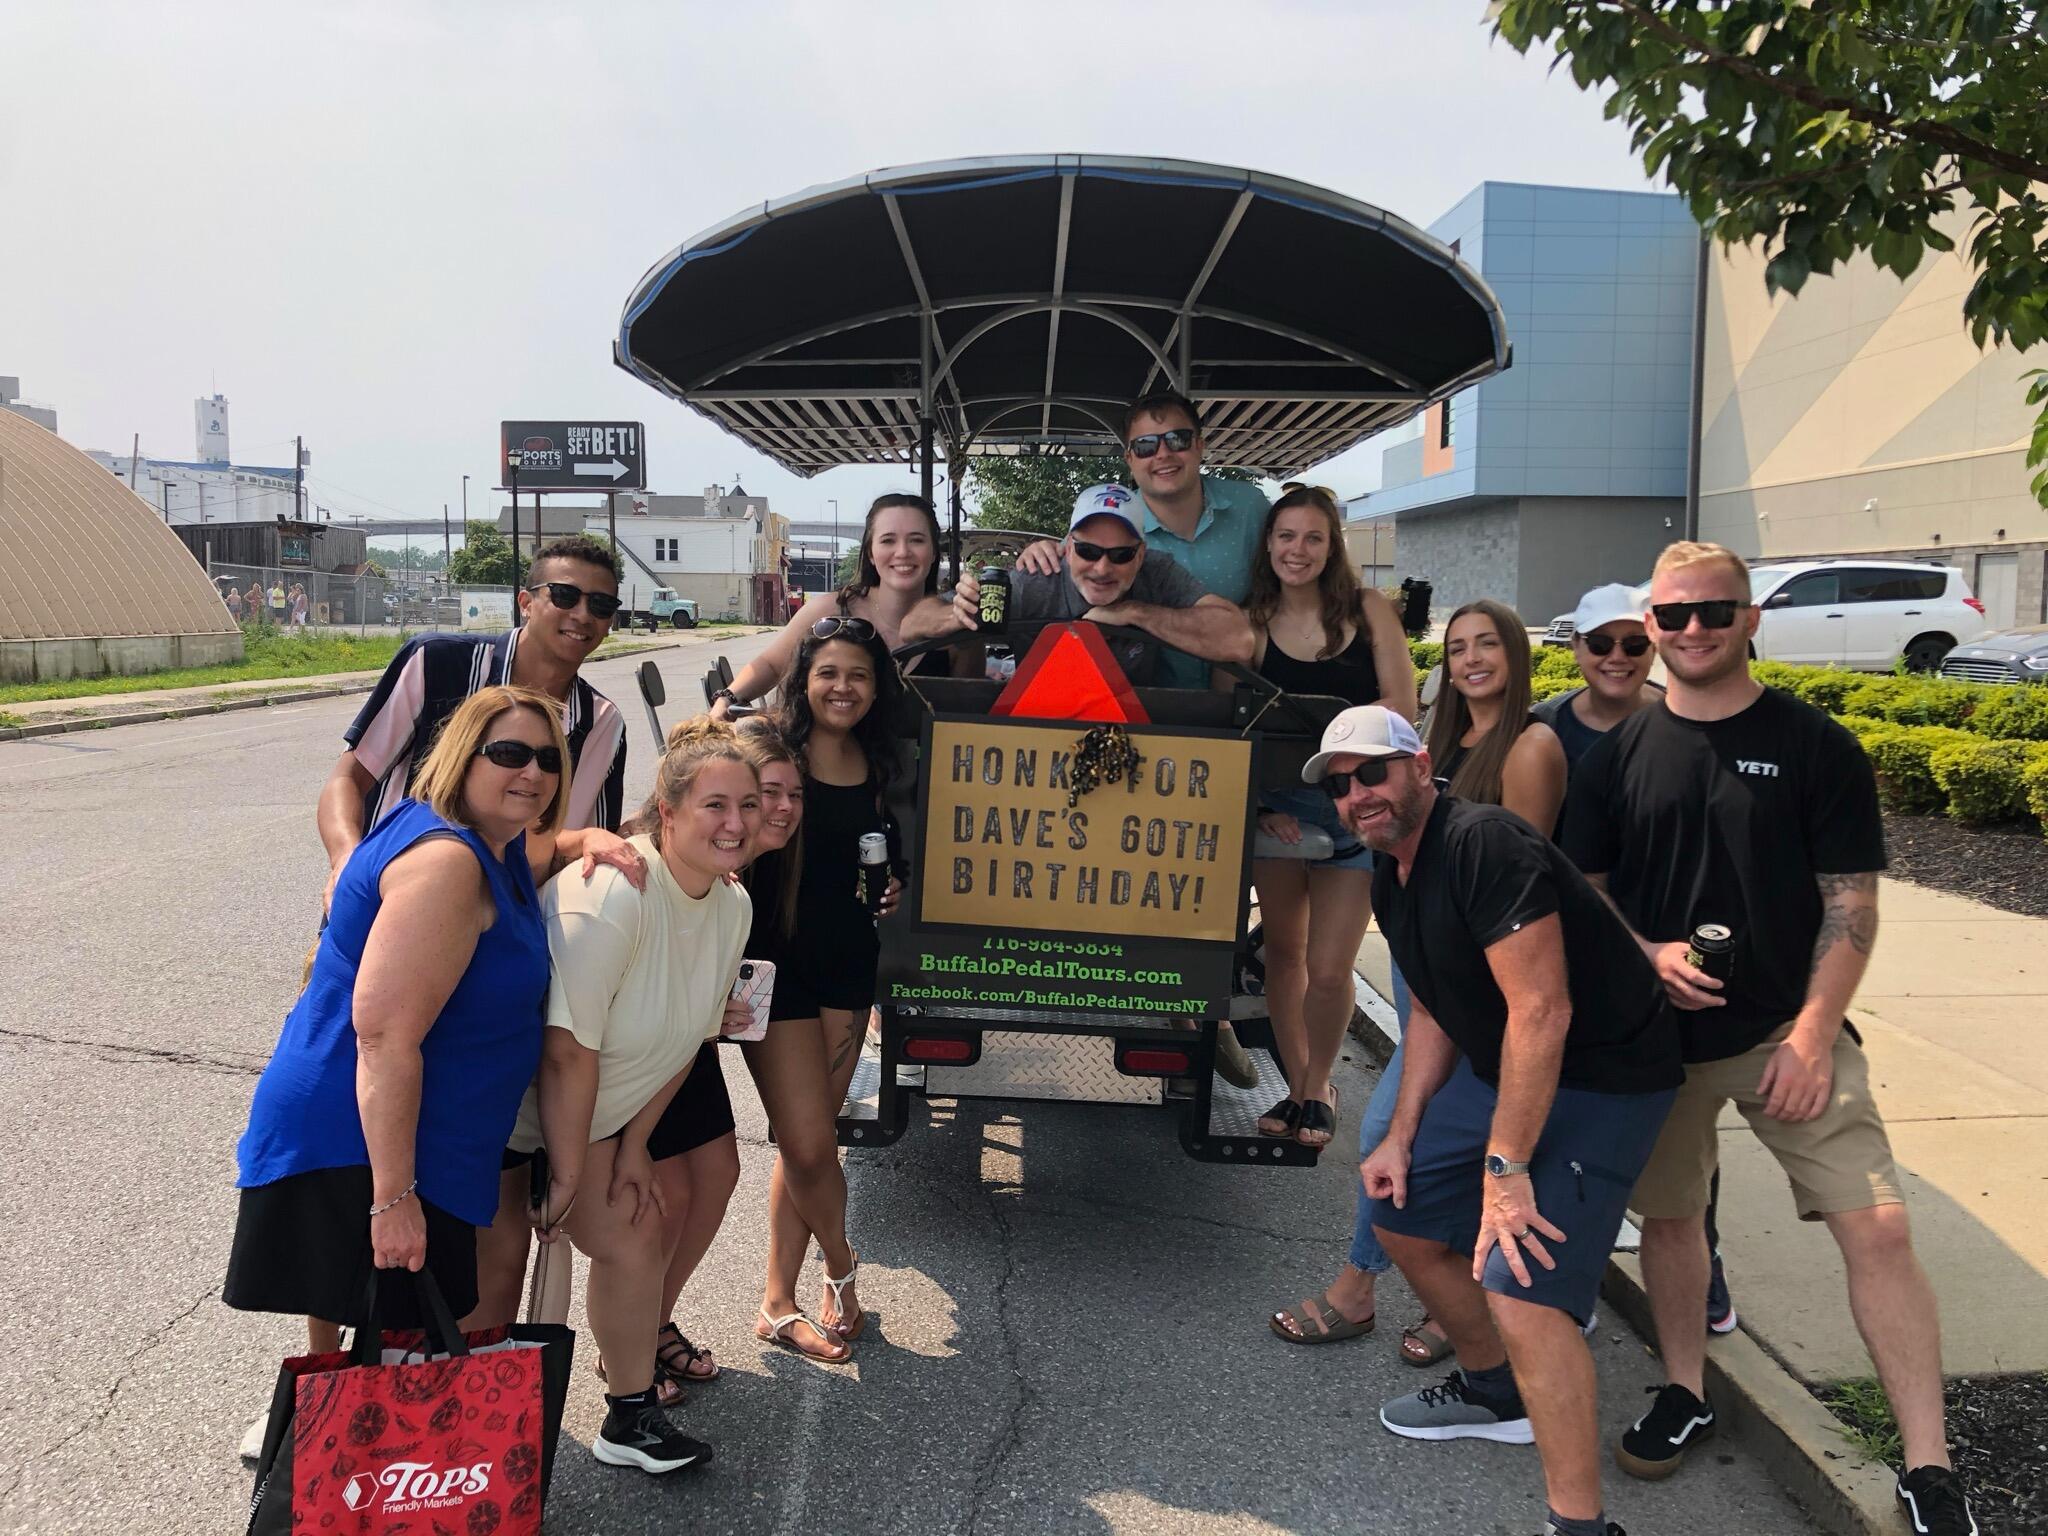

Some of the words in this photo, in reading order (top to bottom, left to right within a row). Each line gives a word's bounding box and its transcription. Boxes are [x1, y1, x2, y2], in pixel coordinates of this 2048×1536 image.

[568, 427, 590, 437] READY
[568, 437, 590, 455] SET
[592, 427, 635, 455] BET!
[952, 744, 1070, 790] HONK
[1127, 752, 1210, 799] FOR
[1736, 760, 1779, 777] YETI
[954, 805, 1089, 850] DAVE'S
[1120, 815, 1220, 862] 60TH
[953, 857, 1205, 914] BIRTHDAY!
[919, 954, 1183, 985] BuffaloPedalTours.com
[891, 984, 1208, 1014] Facebook.com/BuffaloPedalToursNY
[383, 1500, 422, 1515] Friendly
[424, 1496, 463, 1509] Markets
